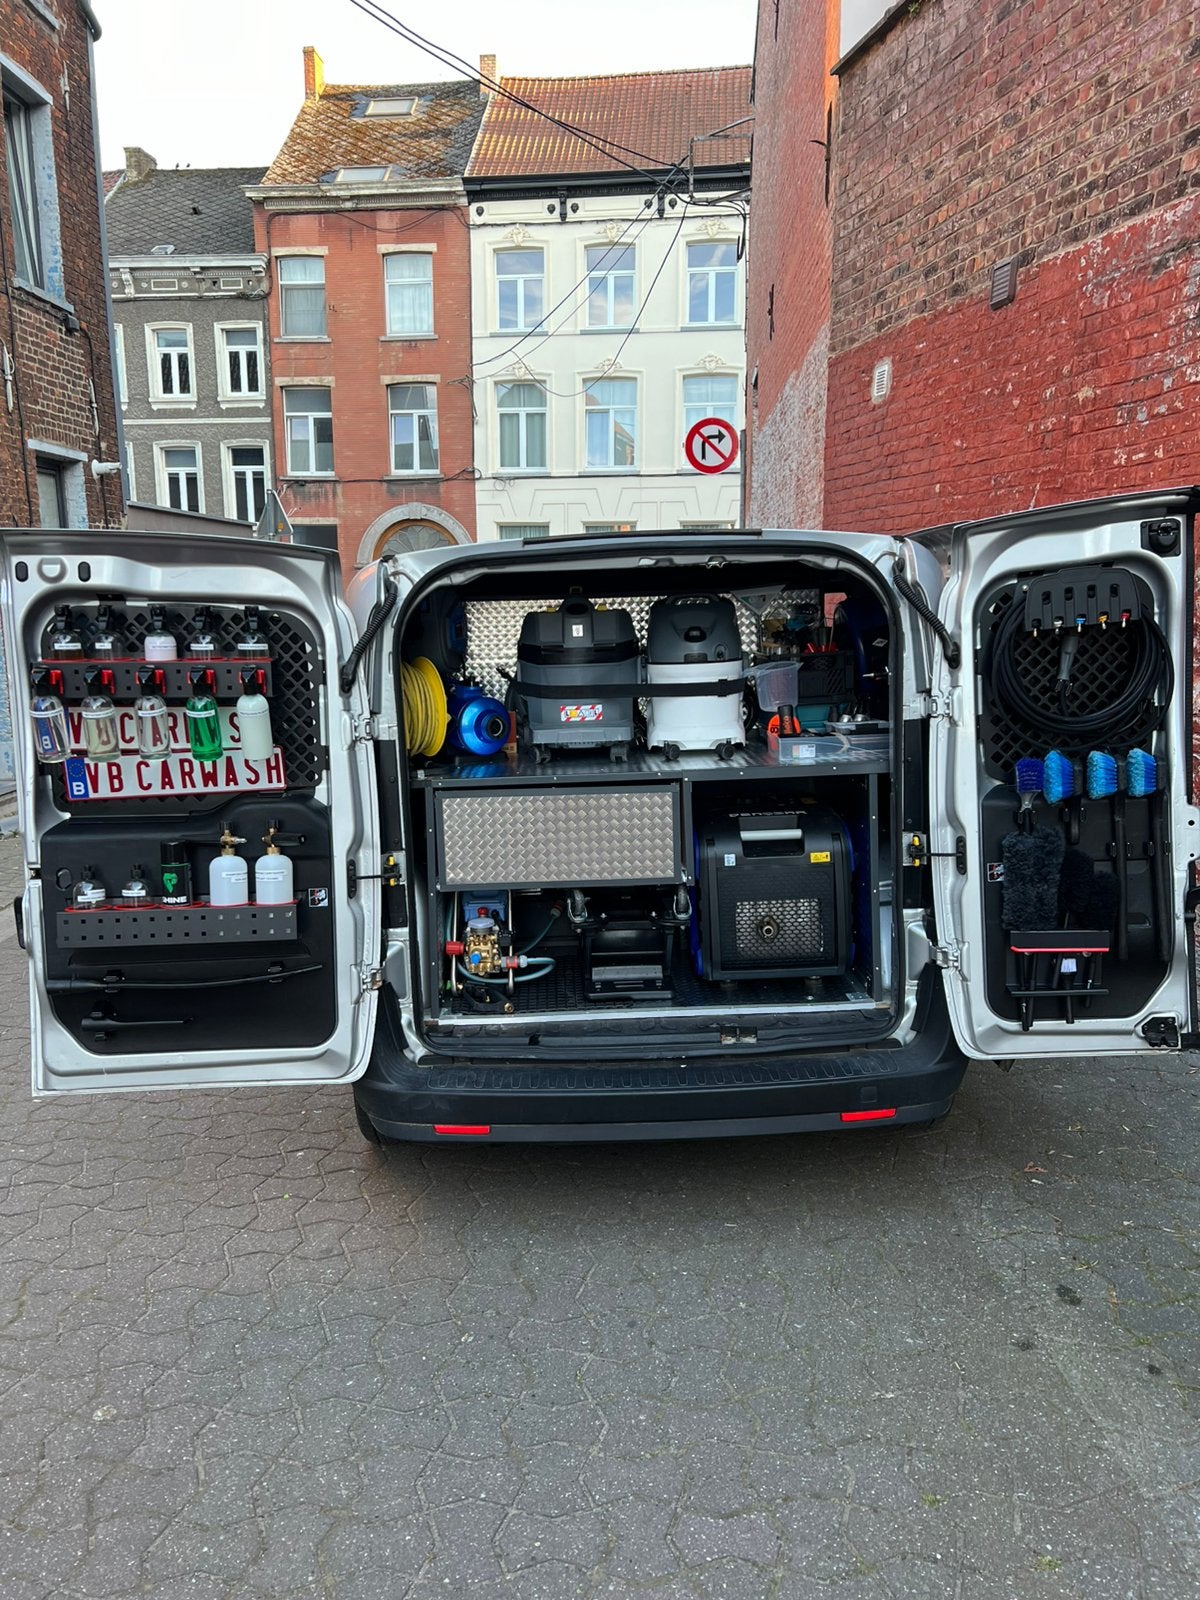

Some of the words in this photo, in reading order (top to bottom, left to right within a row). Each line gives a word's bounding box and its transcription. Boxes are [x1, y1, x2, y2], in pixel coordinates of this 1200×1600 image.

[85, 761, 124, 793] VB
[136, 753, 283, 791] CARWASH
[72, 781, 85, 795] B
